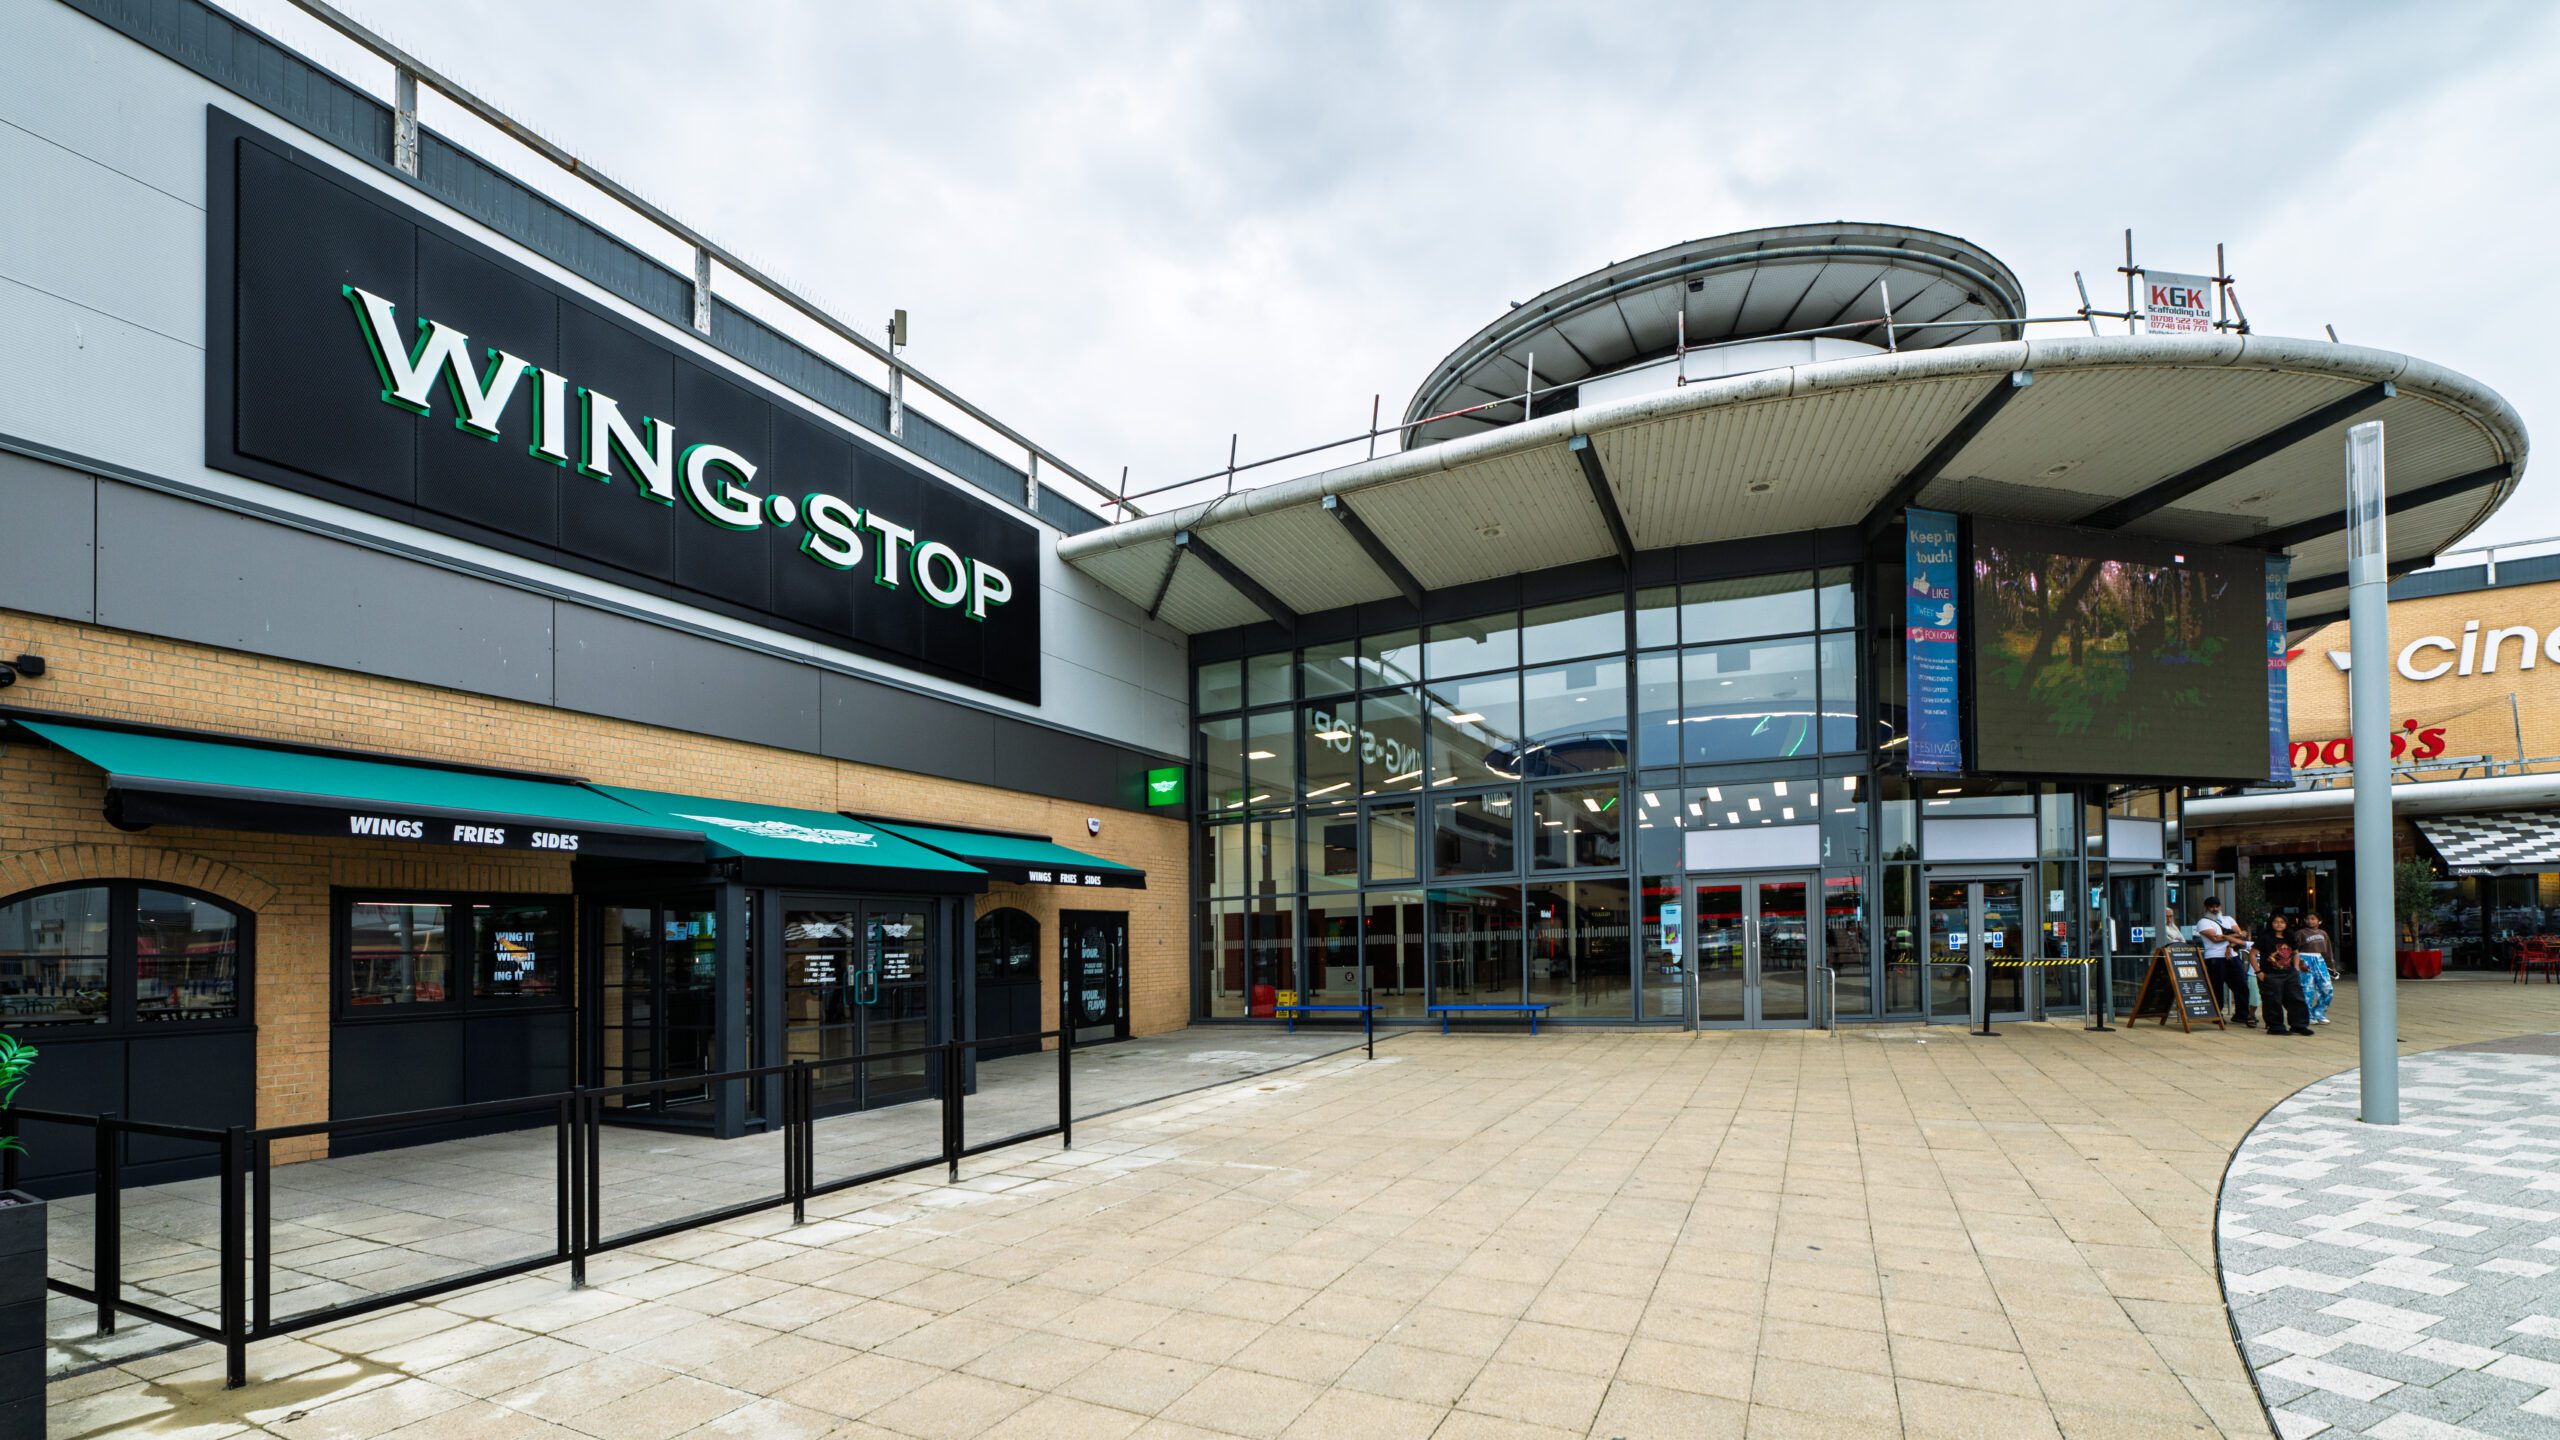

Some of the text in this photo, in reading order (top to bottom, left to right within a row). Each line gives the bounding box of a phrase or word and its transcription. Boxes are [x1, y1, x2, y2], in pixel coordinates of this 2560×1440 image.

[2151, 285, 2205, 310] KGK
[2147, 304, 2210, 317] Scaffolding Ltd
[1910, 529, 1956, 546] Keep in
[1916, 548, 1953, 563] touch!
[1931, 587, 1950, 599] LIKE
[1924, 629, 1956, 641] FOLLOW
[2397, 619, 2560, 682] cin
[350, 816, 579, 850] WINGS FRIES SIDES
[1028, 871, 1101, 885] WINGS FRIES SIDES
[495, 932, 522, 941] WING
